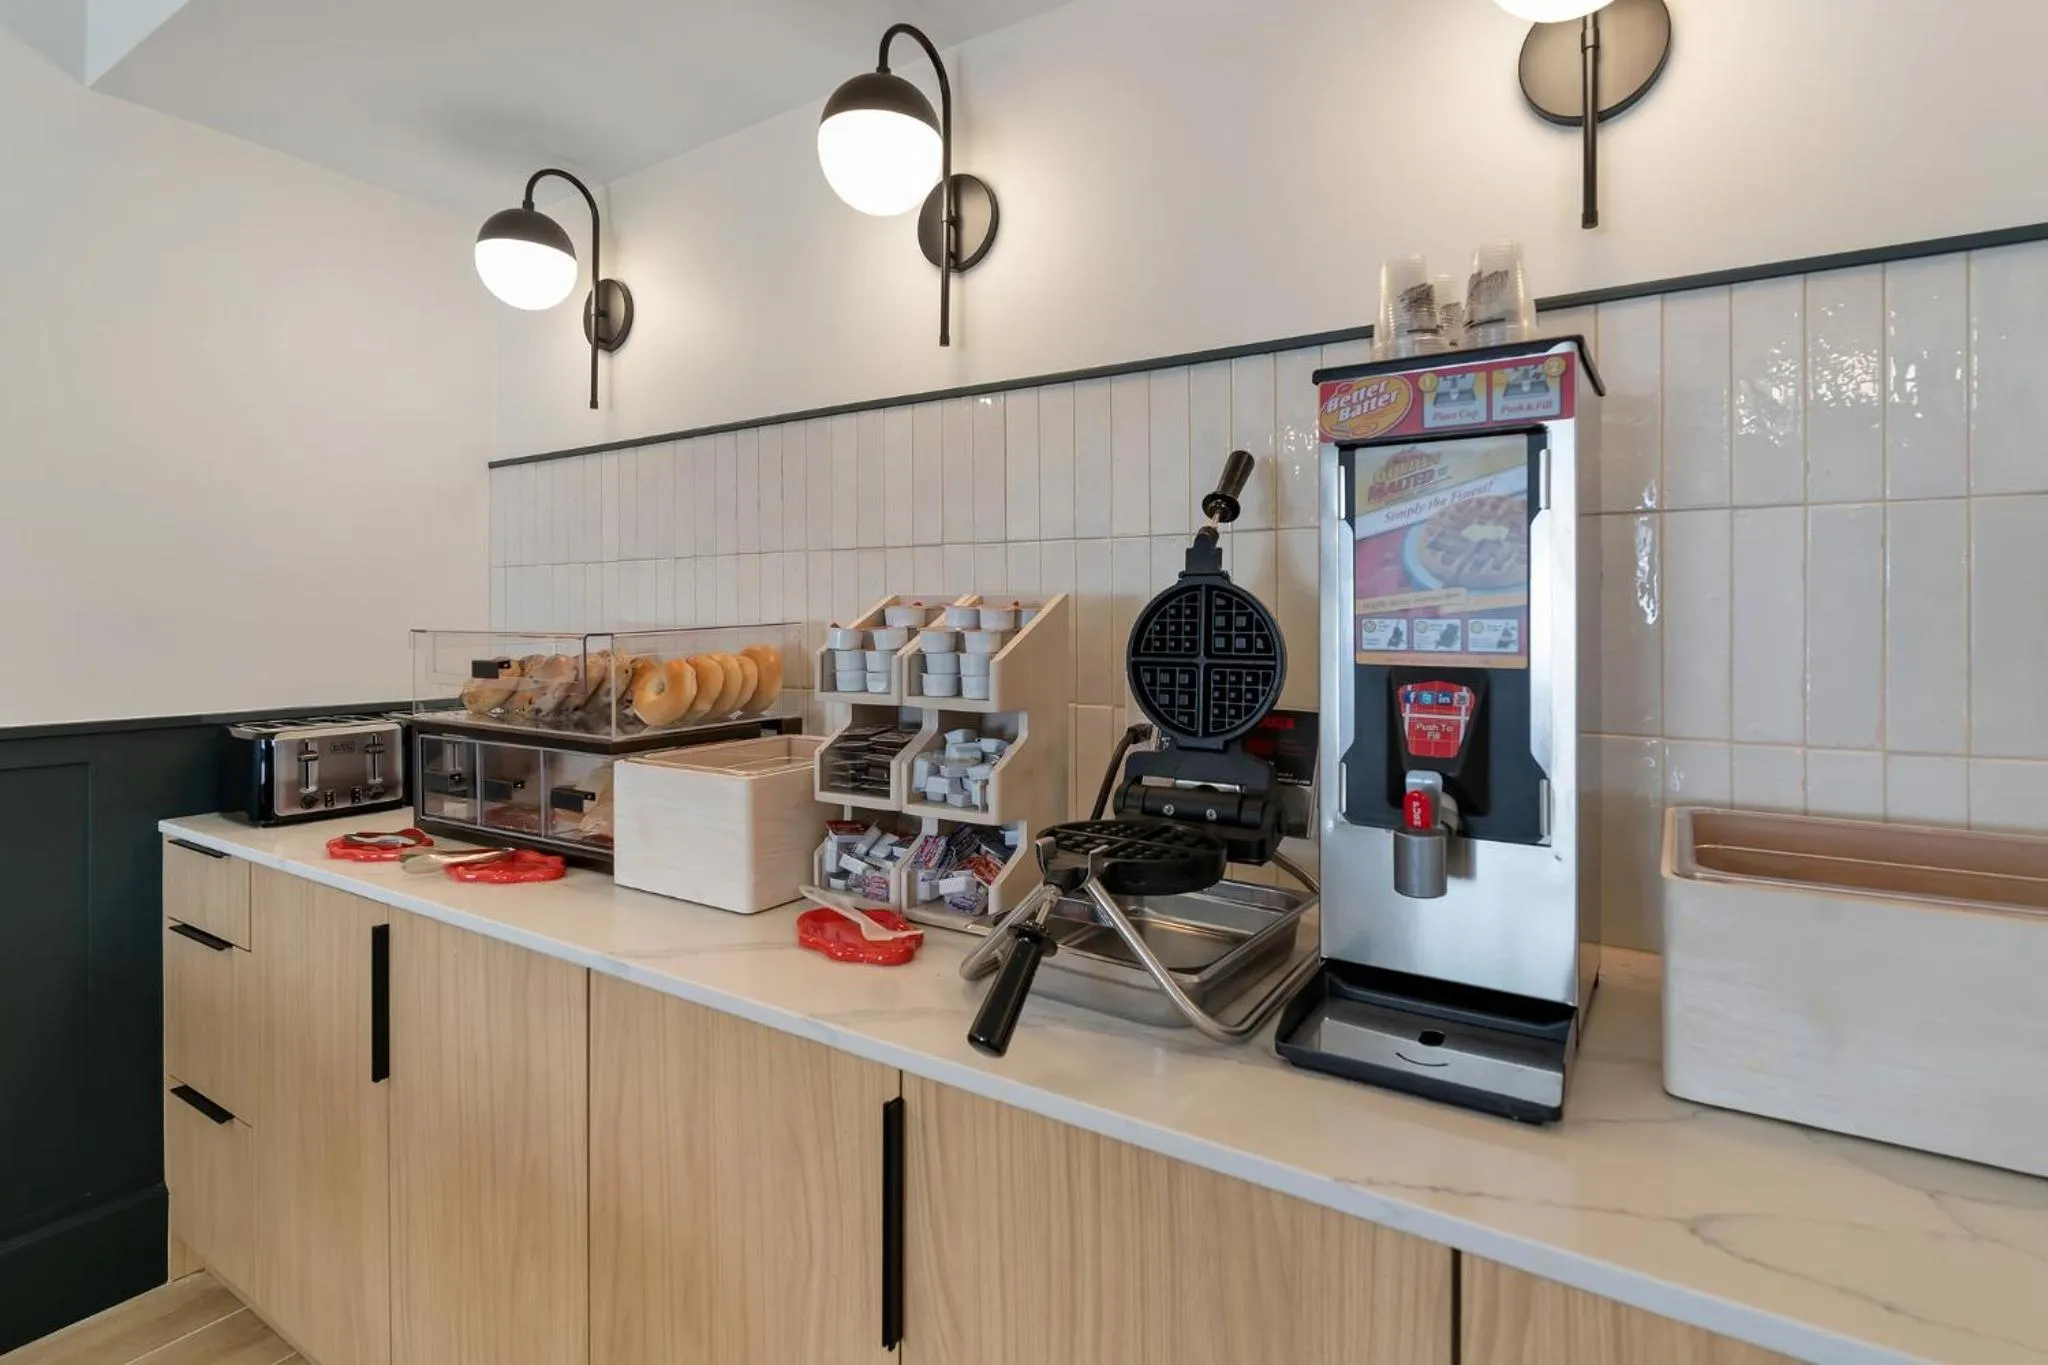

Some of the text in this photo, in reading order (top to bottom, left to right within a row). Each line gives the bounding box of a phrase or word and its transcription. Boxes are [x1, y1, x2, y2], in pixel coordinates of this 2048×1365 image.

[1326, 379, 1388, 413] Better
[1338, 390, 1399, 422] Batter
[1416, 722, 1454, 732] Push To
[1427, 731, 1441, 740] Fill
